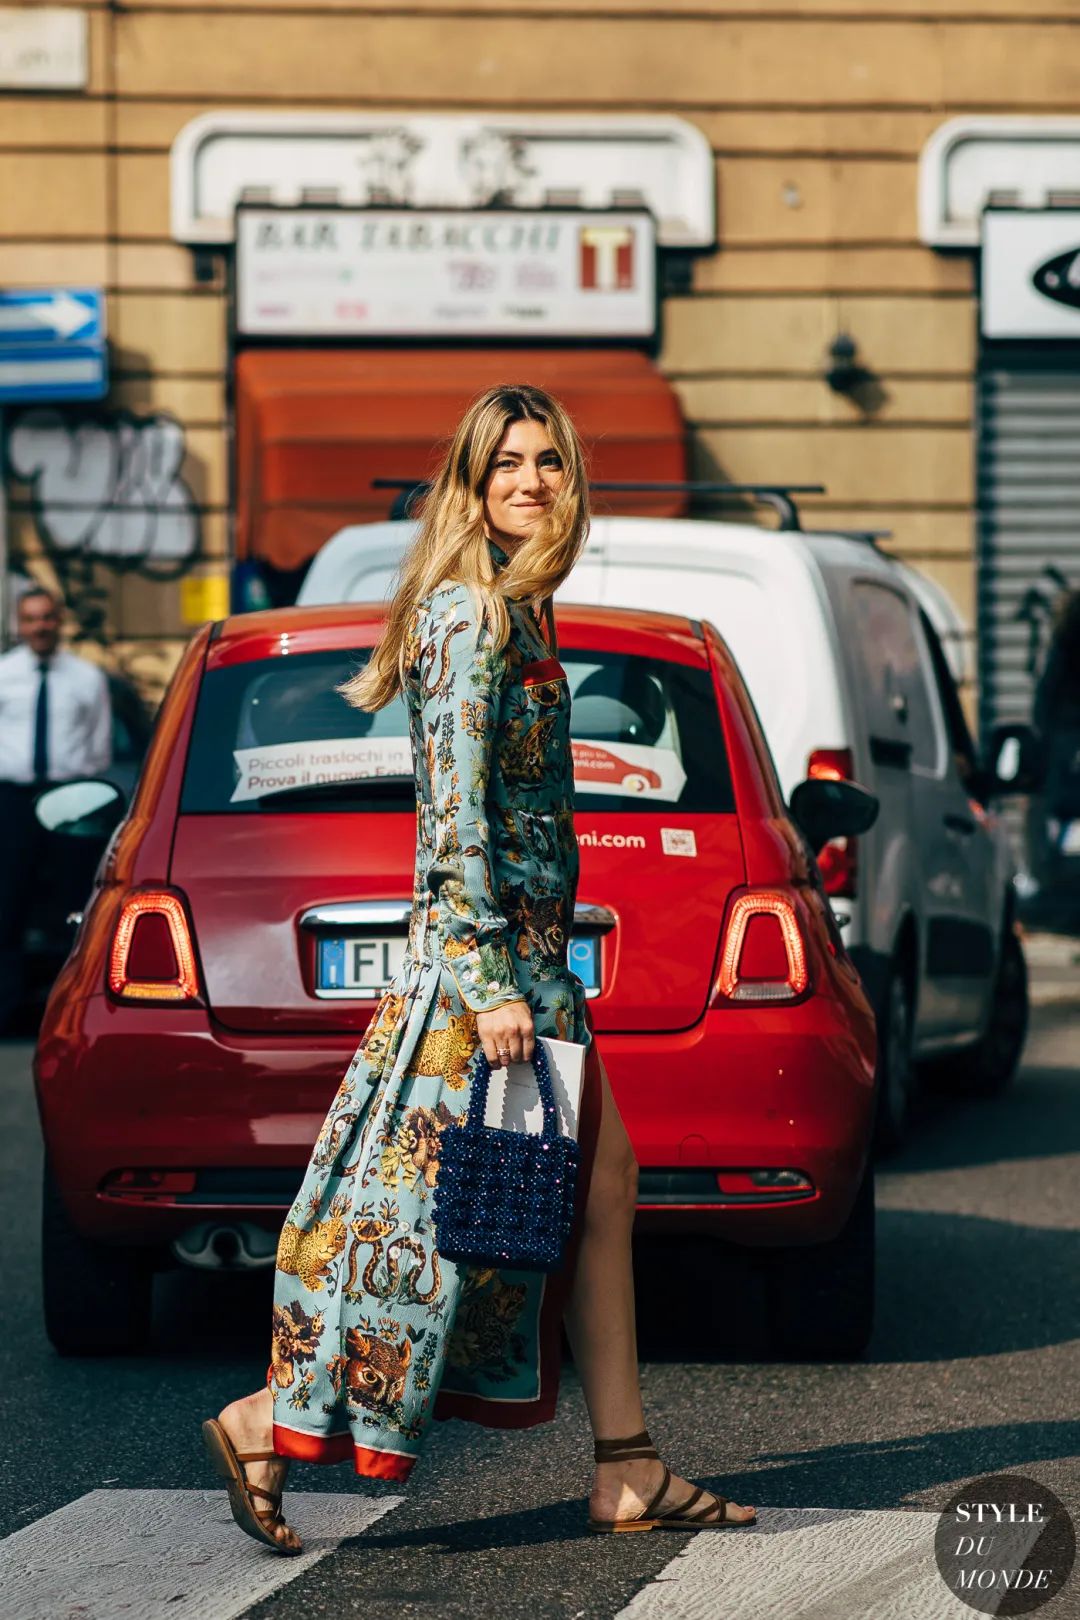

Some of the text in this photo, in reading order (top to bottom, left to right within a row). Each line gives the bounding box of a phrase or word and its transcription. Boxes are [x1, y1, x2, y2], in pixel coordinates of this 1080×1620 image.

[256, 222, 561, 252] BAR TABACCHI
[581, 226, 634, 289] T
[249, 750, 404, 771] Piccoli traslochi in
[248, 775, 296, 789] Prova
[301, 771, 311, 783] il
[575, 830, 646, 849] ni.com
